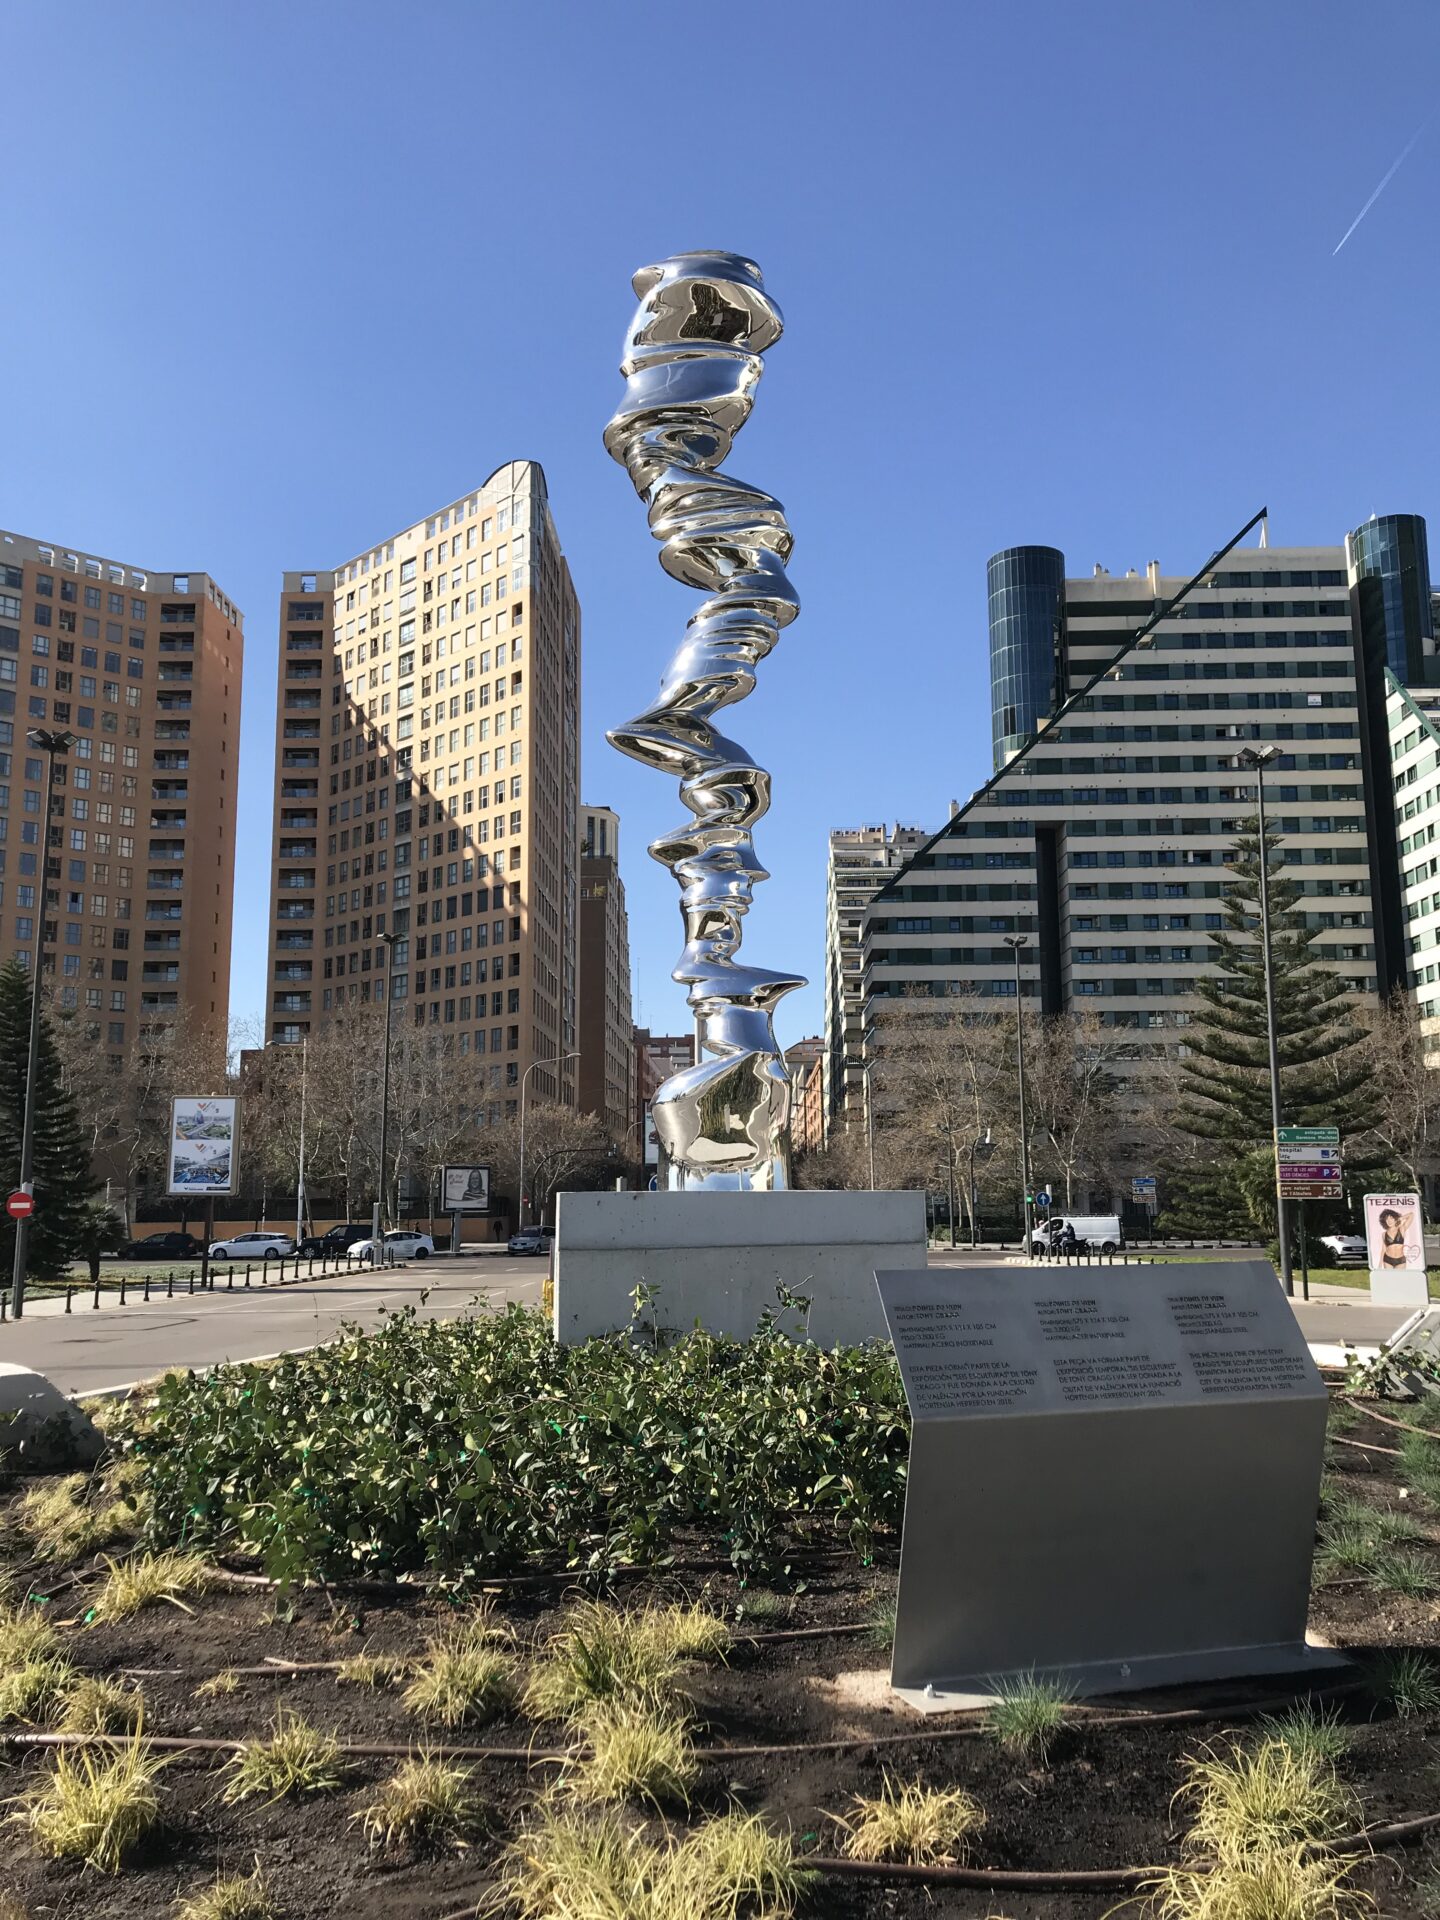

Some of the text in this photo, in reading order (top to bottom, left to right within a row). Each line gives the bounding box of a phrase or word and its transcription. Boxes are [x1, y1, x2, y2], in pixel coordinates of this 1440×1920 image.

[1323, 1168, 1330, 1177] P
[1368, 1196, 1415, 1206] TEZENIS
[927, 1340, 955, 1348] ACERO
[970, 1362, 991, 1370] PARTE
[1000, 1361, 1010, 1369] LA
[1068, 1358, 1087, 1366] PEÇA
[1095, 1365, 1127, 1373] TEMPORAL
[1256, 1365, 1285, 1373] DONATED
[912, 1373, 952, 1382] EXPOSICIÓN
[1138, 1372, 1168, 1380] DONADA
[960, 1380, 992, 1389] DONADA
[1008, 1378, 1035, 1386] CIUDAD
[1149, 1379, 1182, 1389] FUNDACIÓ
[1199, 1378, 1212, 1386] CITY
[916, 1393, 927, 1401] DE
[961, 1391, 977, 1399] POR
[986, 1387, 1028, 1397] FUNDACIÓN
[1100, 1391, 1129, 1400] HERRERO
[956, 1399, 987, 1408] HERRERO
